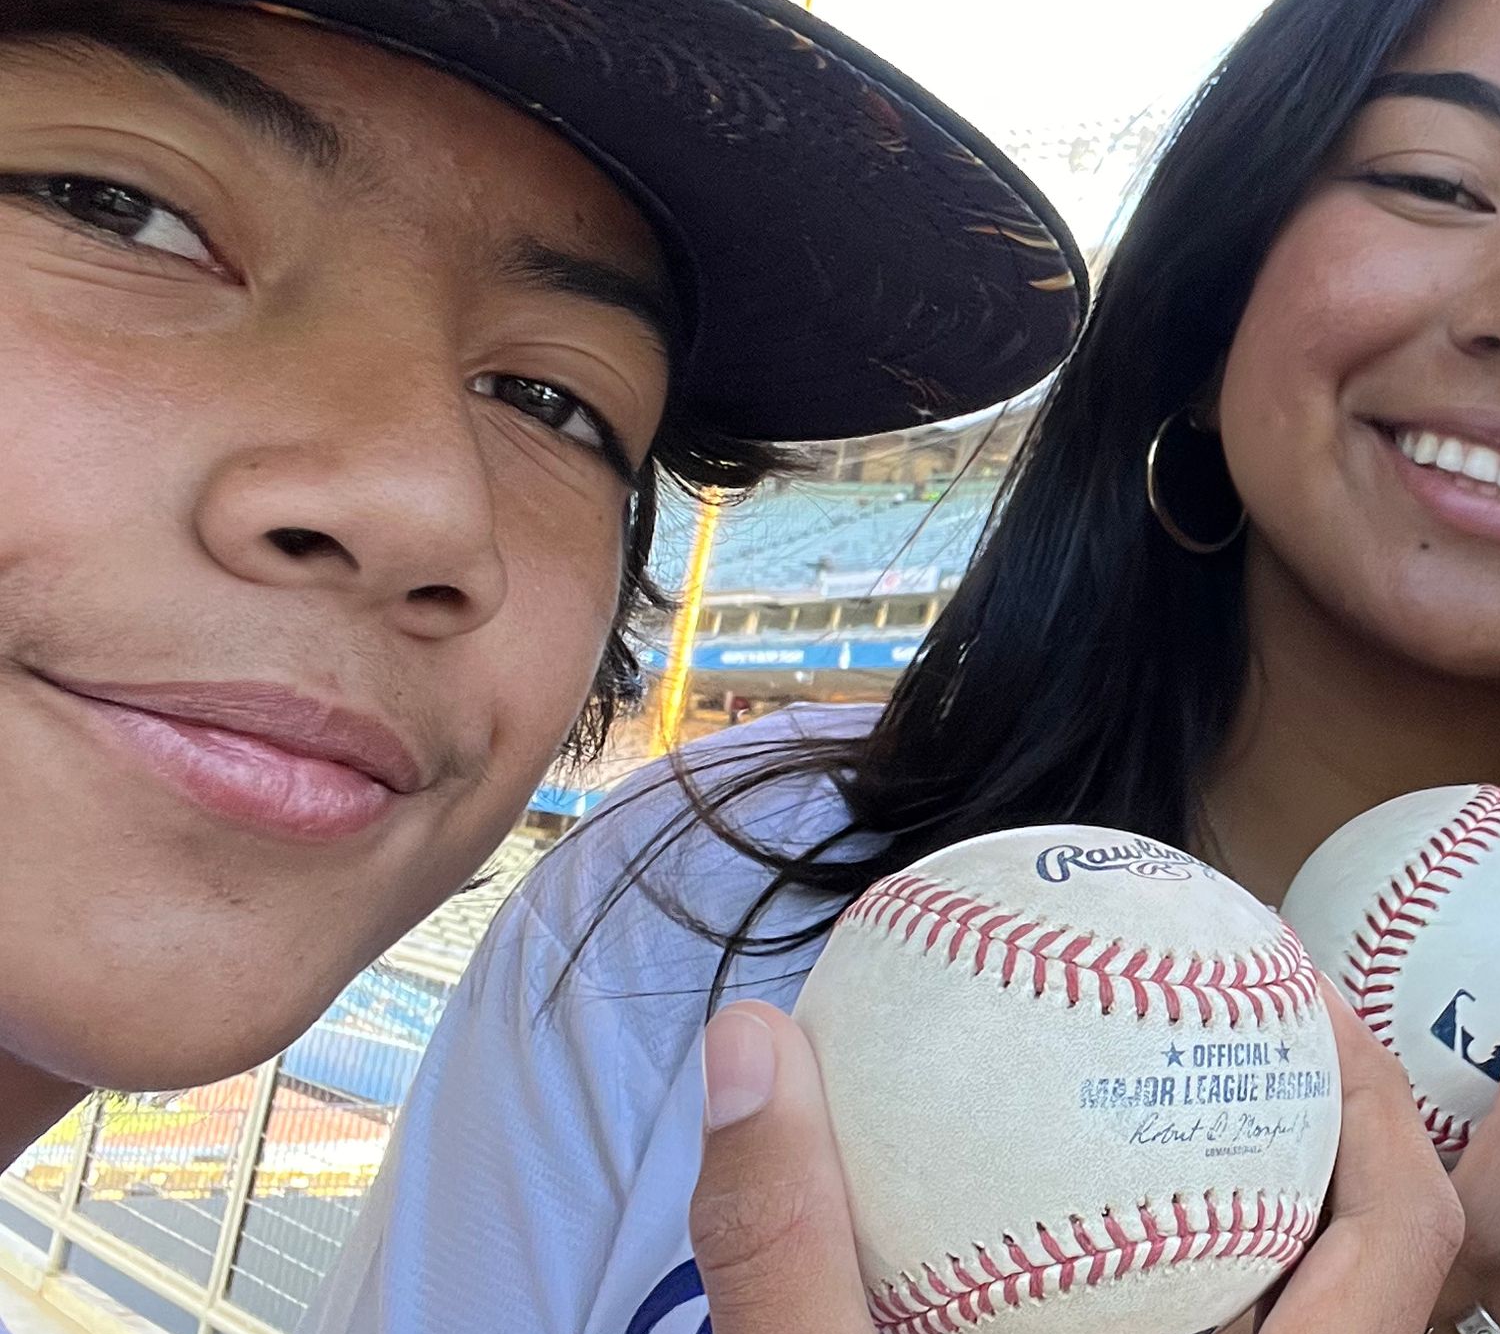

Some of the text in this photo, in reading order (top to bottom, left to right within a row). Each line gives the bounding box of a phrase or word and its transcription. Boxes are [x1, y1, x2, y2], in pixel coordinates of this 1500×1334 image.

[1036, 838, 1216, 882] Rawling
[1192, 1042, 1271, 1067] OFFICIAL
[1183, 1073, 1259, 1105] LEAGUE
